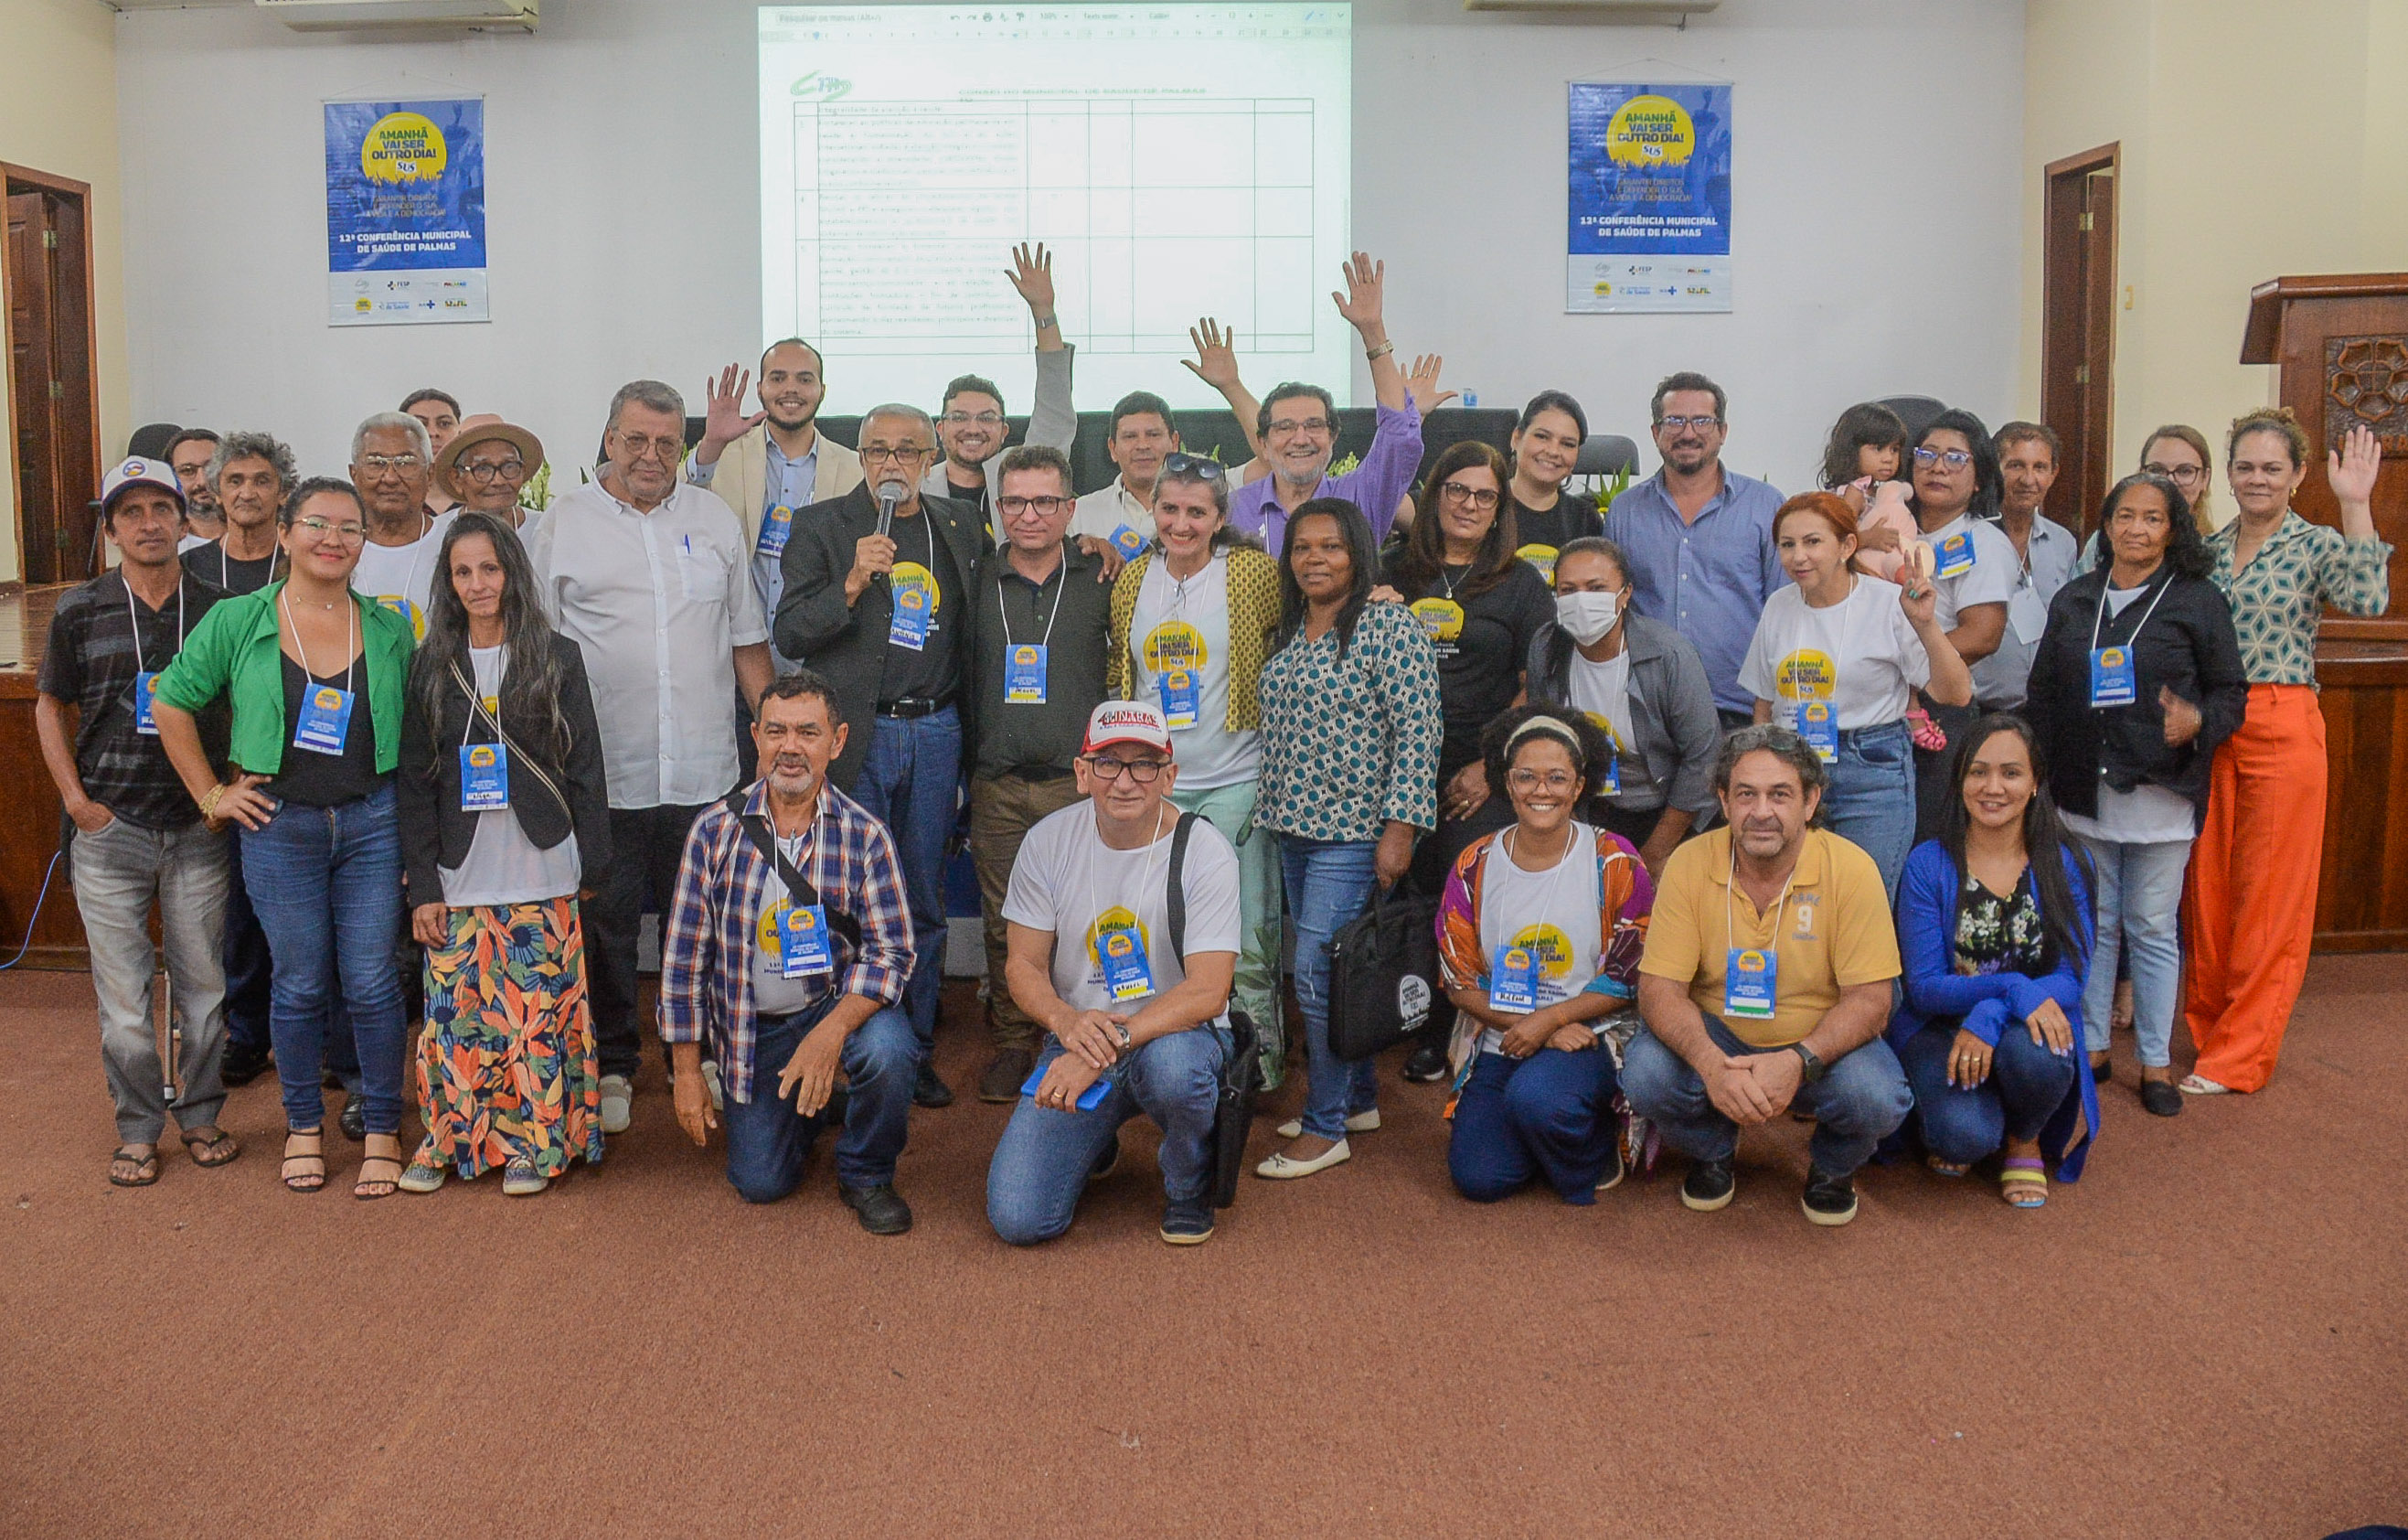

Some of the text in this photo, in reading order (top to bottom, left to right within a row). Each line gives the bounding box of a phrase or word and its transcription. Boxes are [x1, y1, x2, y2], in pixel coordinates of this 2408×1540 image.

[1625, 111, 1677, 123] AMANHÃ
[379, 126, 429, 139] AMANHÃ
[1628, 123, 1673, 133] VAI SER
[1617, 133, 1684, 143] OUTRO DIA!
[382, 139, 425, 149] VAI SER
[372, 149, 437, 160] OUTRO DIA!
[1643, 144, 1662, 156] SUS
[397, 161, 416, 173] SUS
[1599, 214, 1665, 226] CONFERÊNCIA
[1667, 216, 1718, 226] MUNICIPAL
[357, 230, 421, 242] CONFERÊNCIA
[421, 230, 472, 241] MUNICIPAL
[1598, 226, 1701, 237] DE SAÚDE DE PALMAS
[357, 242, 456, 253] DE SAÚDE DE PALMAS
[1154, 631, 1192, 643] AMANHÃ
[1172, 641, 1190, 649] SER
[1170, 658, 1184, 666] SUS
[1786, 659, 1824, 668] AMANHÃ
[1812, 676, 1829, 684] DIA!
[1799, 685, 1813, 693] SUS
[1797, 904, 1813, 933] 9
[1518, 935, 1559, 947] AMANHÃ
